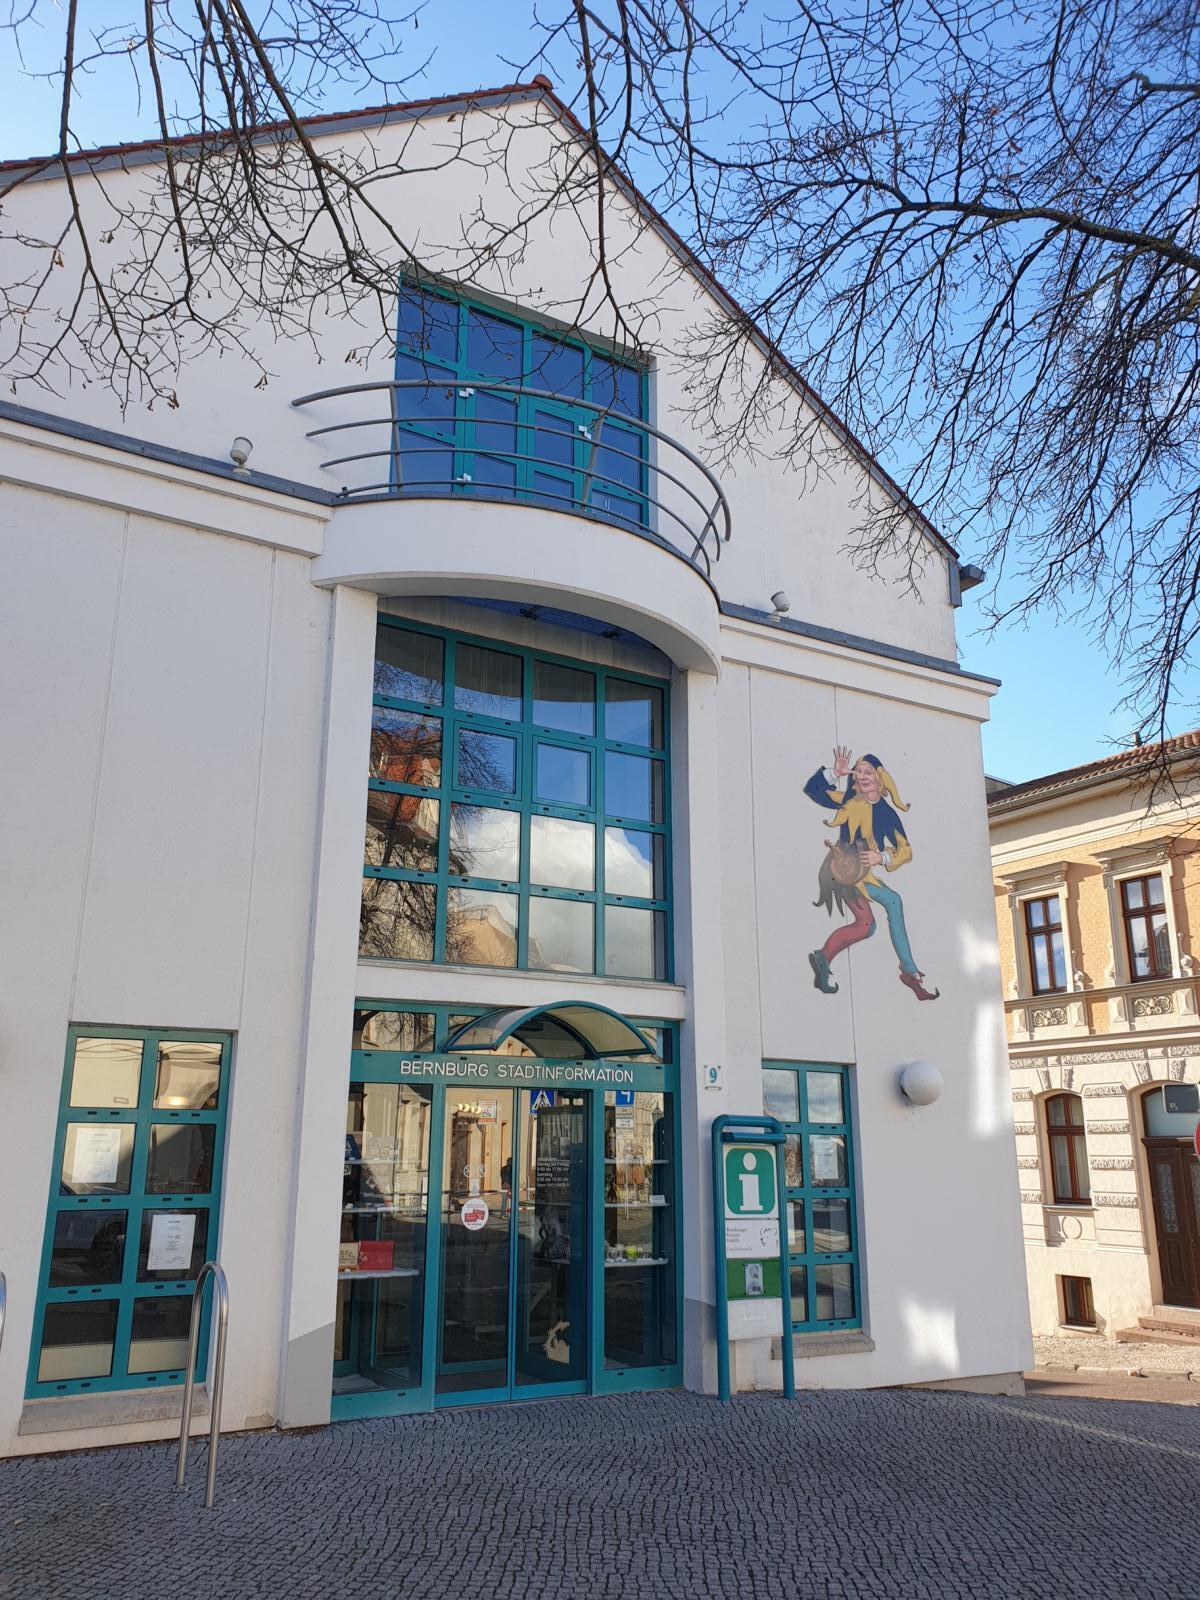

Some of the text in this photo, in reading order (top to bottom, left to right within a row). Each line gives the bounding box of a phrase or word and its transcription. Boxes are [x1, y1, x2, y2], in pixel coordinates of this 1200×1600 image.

[400, 1060, 634, 1083] BERNBURG STADTINFORMATION
[709, 1067, 718, 1083] 9
[738, 1152, 763, 1211] i
